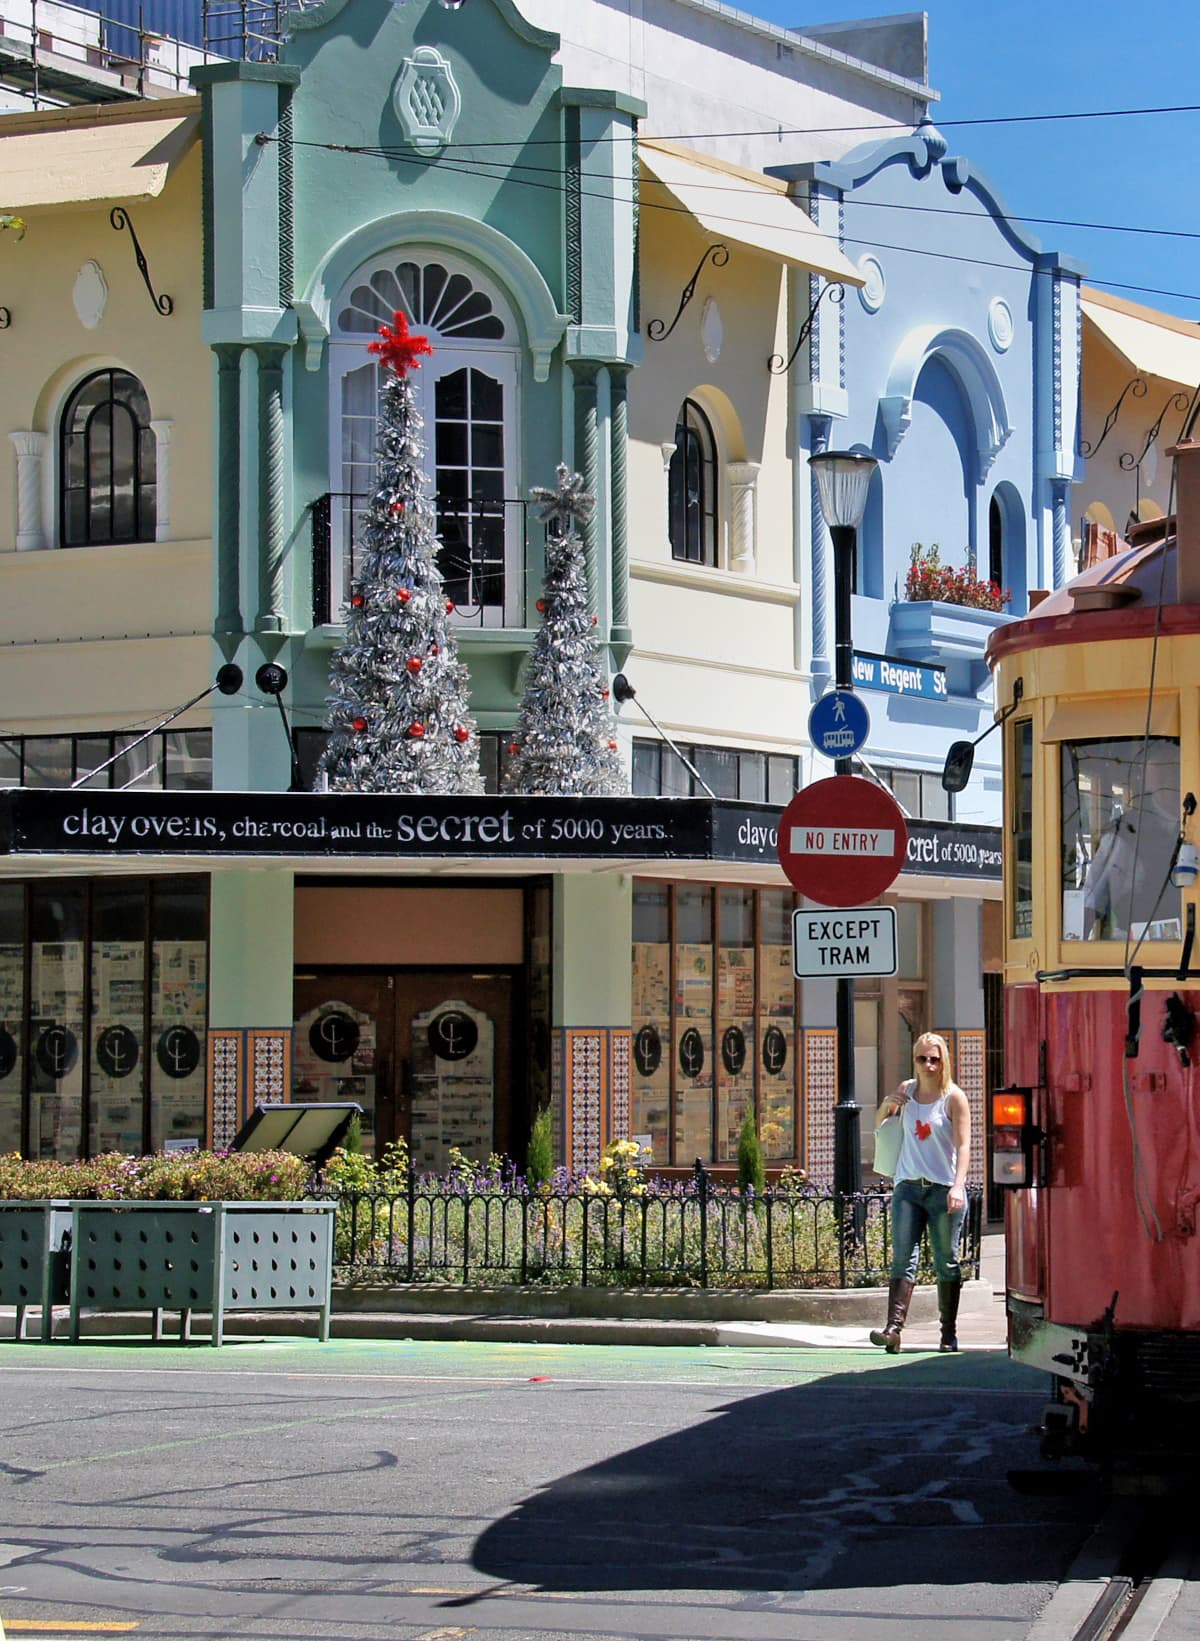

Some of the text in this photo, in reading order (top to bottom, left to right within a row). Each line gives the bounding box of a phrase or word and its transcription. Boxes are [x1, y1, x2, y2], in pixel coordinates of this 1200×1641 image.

[880, 661, 922, 693] Regent
[933, 671, 947, 695] St
[63, 807, 127, 844] clay
[232, 816, 327, 838] charcoal
[331, 822, 361, 839] and
[366, 822, 393, 838] the
[397, 810, 515, 843] secret
[522, 818, 546, 839] of
[551, 818, 605, 840] 5000
[738, 818, 768, 853] clay
[806, 831, 879, 851] NO ENTRY
[907, 834, 939, 863] cret
[941, 843, 953, 861] of
[954, 843, 977, 863] 5000
[808, 919, 881, 940] EXCEPT
[818, 946, 870, 966] TRAM
